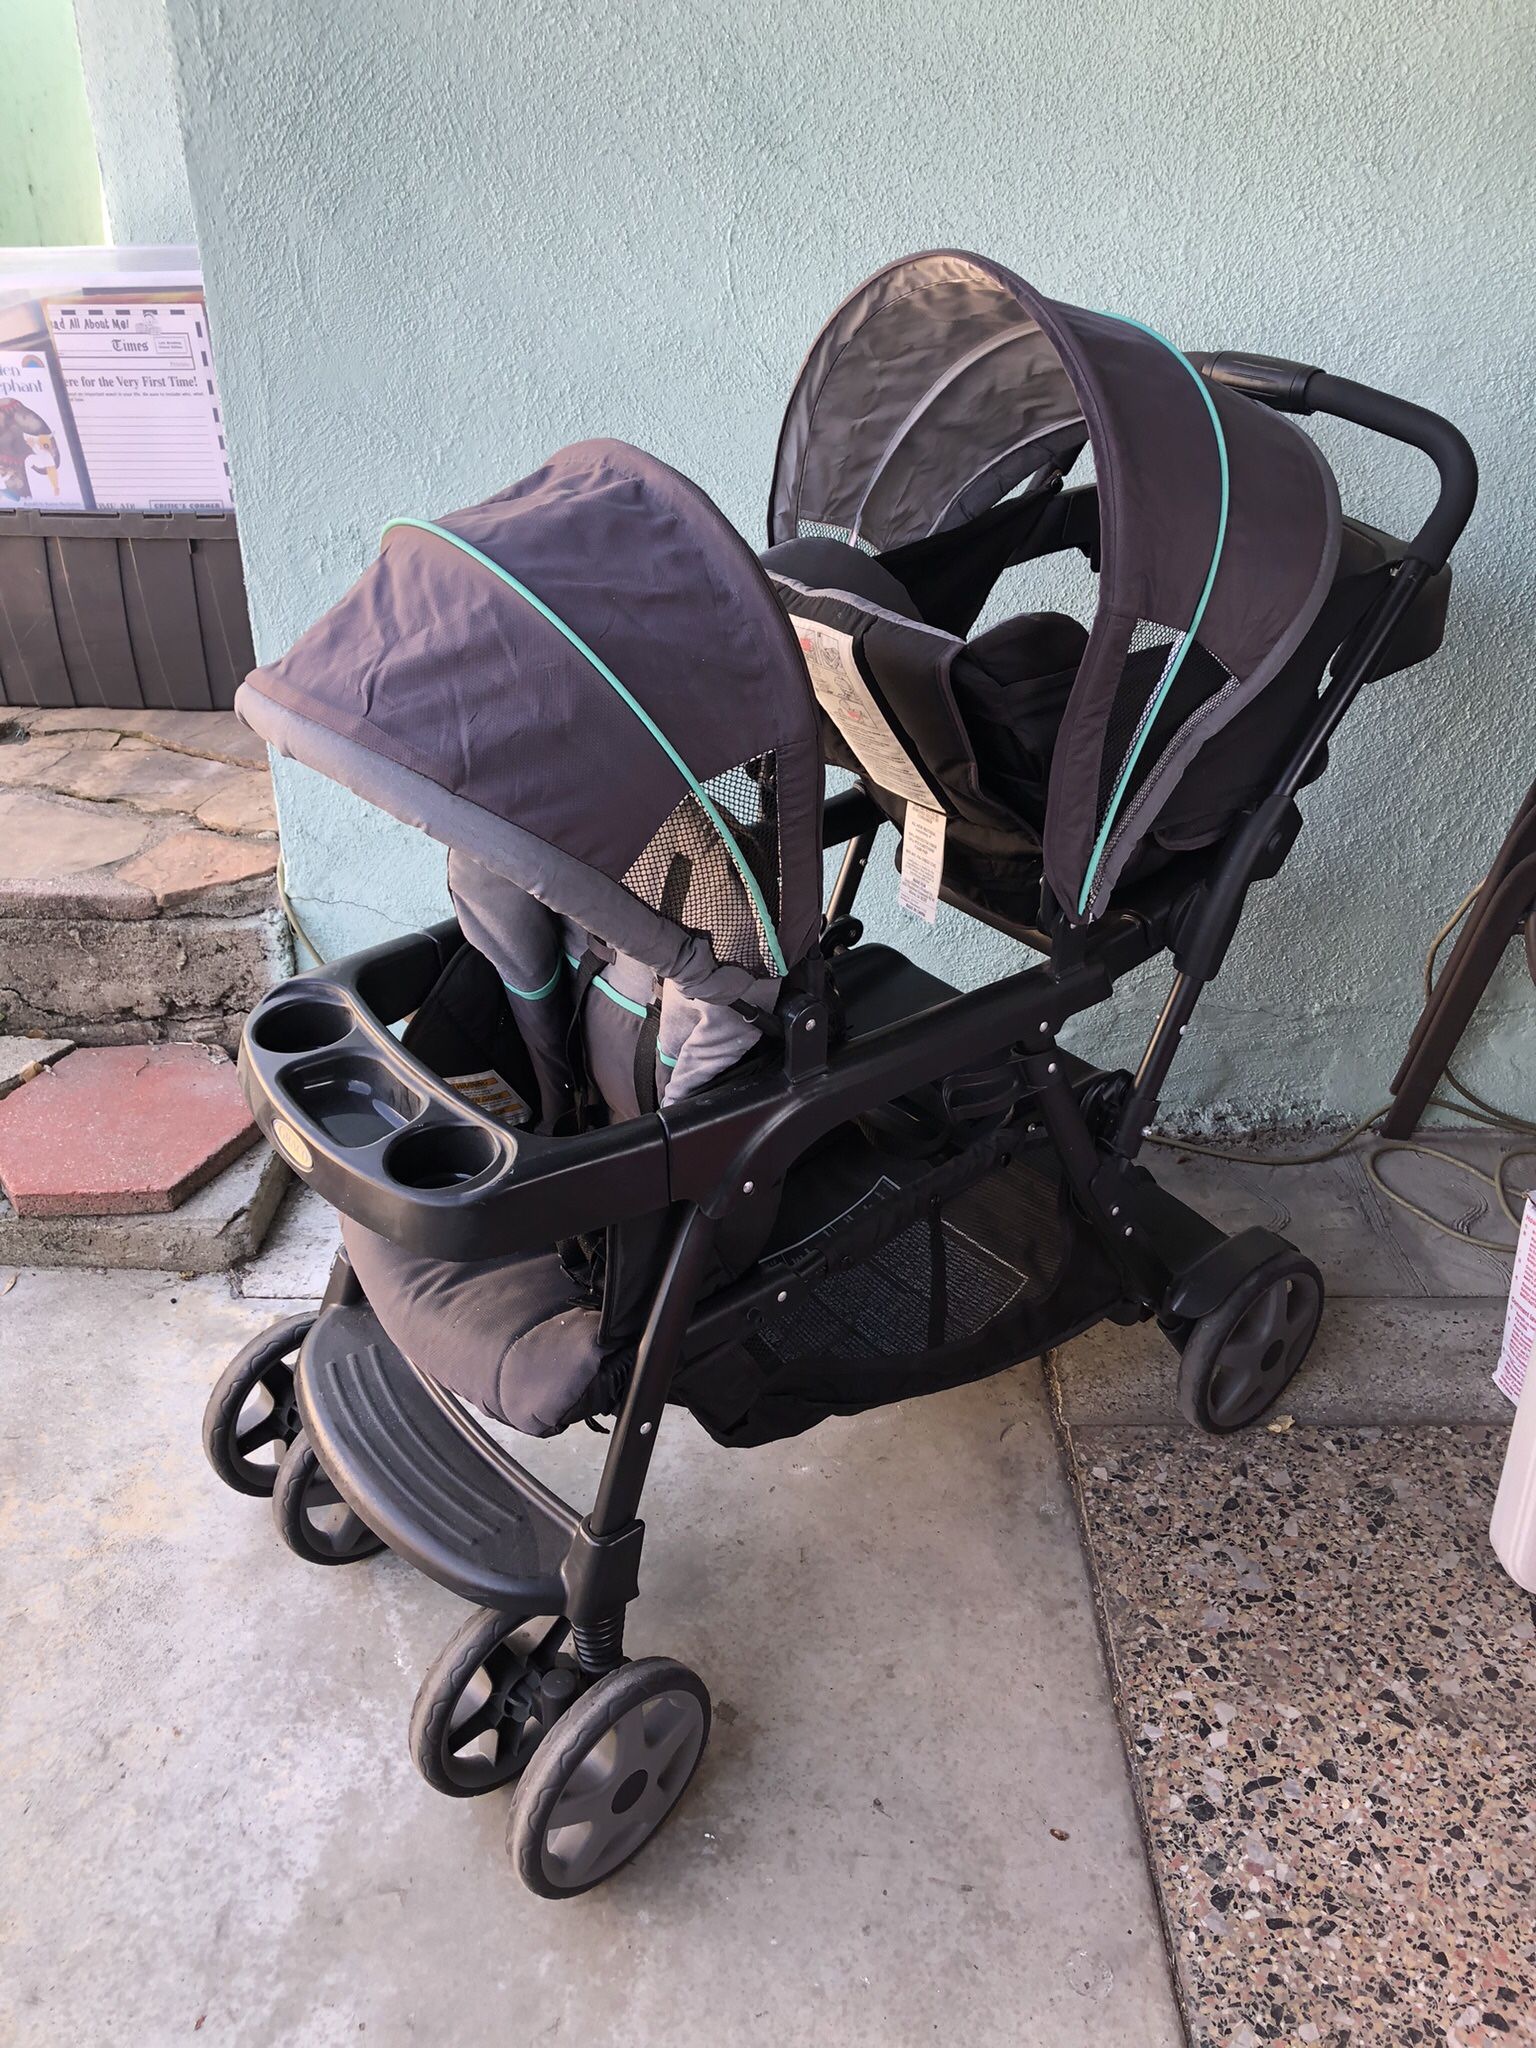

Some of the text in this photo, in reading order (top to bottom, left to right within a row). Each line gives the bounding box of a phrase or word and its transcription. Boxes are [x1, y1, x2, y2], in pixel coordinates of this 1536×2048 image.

[51, 317, 130, 331] ad All About Me!
[111, 339, 149, 352] Times
[80, 375, 96, 388] for
[98, 375, 114, 388] the
[116, 376, 139, 390] Very
[143, 375, 166, 388] First
[168, 375, 198, 388] Time!
